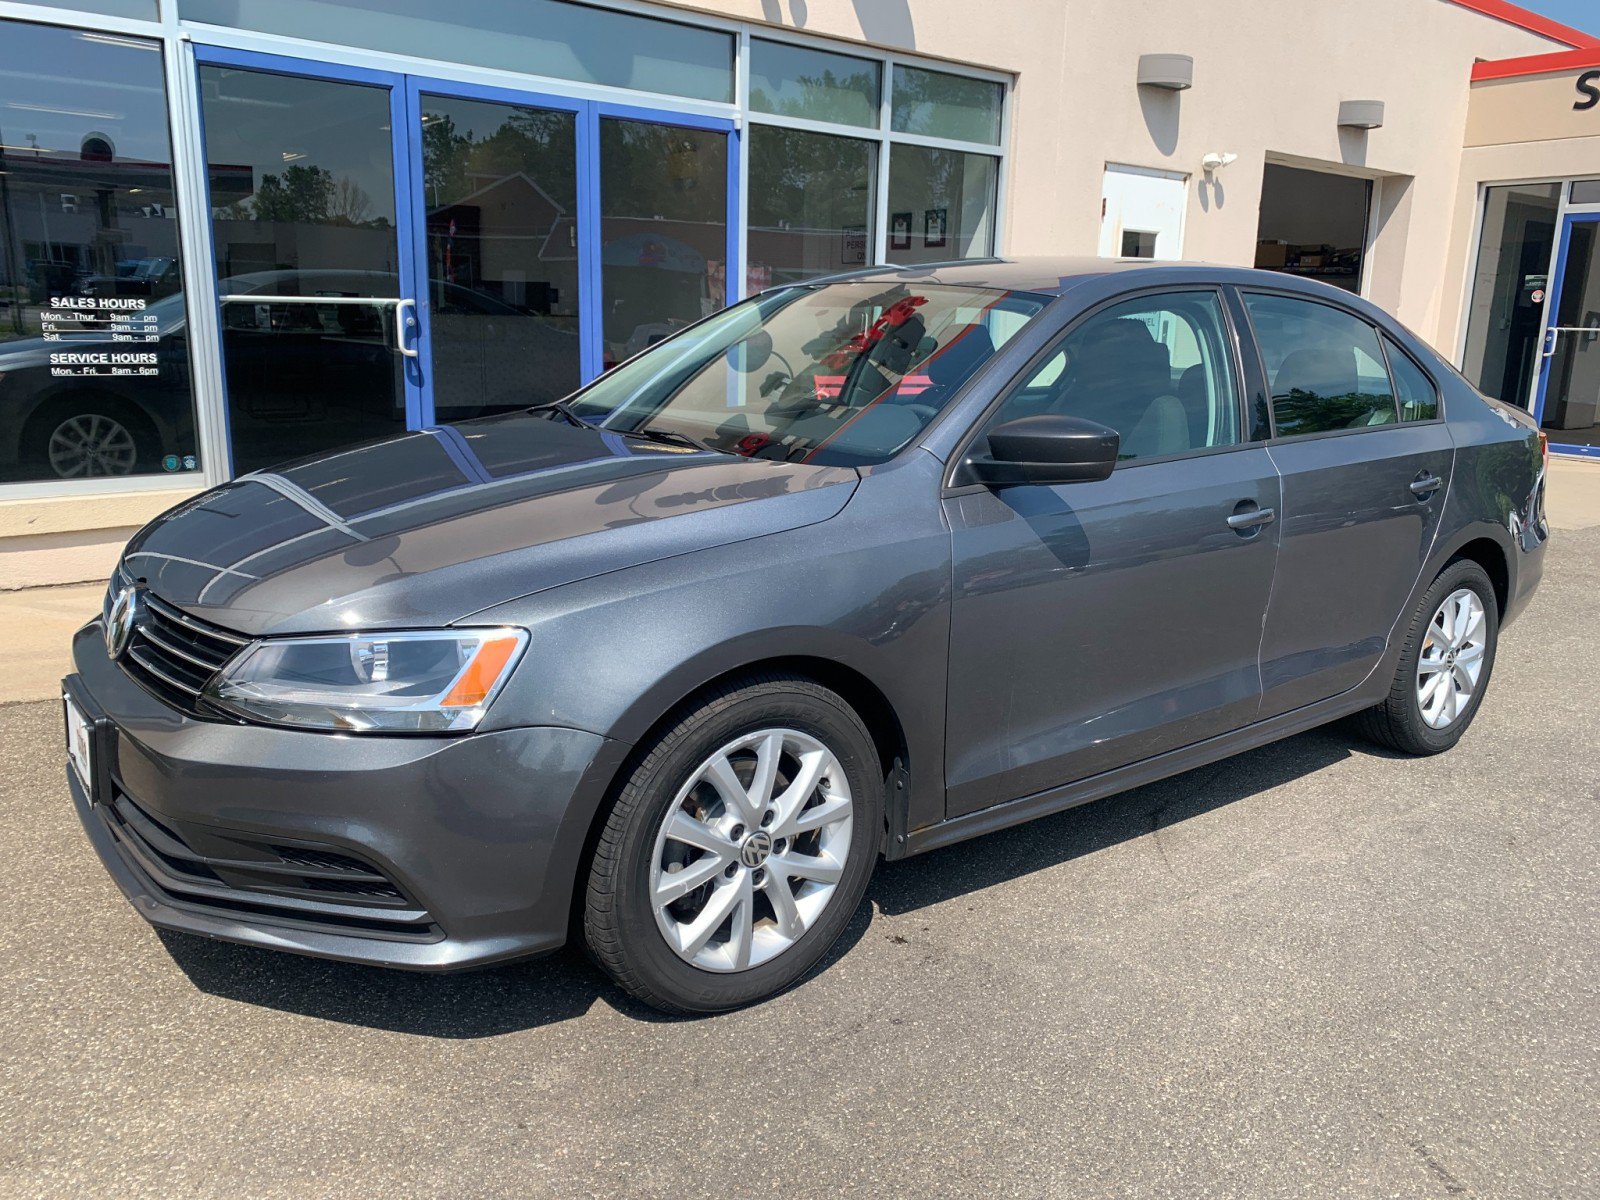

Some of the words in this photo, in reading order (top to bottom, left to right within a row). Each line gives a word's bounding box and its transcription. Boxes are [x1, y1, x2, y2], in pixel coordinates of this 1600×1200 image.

[50, 297, 96, 309] SALES
[98, 298, 146, 310] HOURS
[40, 312, 64, 321] Mon.
[72, 312, 97, 321] Thur.
[109, 313, 130, 322] 9am
[143, 315, 158, 323] pm
[41, 322, 58, 331] Fri.
[110, 323, 131, 332] 9am
[143, 324, 158, 333] pm
[42, 332, 62, 341] Sat.
[112, 333, 132, 342] 9am
[145, 334, 160, 343] pm
[49, 353, 108, 364] SERVICE
[111, 353, 157, 364] HOURS
[50, 367, 75, 375] Mon.
[82, 367, 98, 375] Fri.
[111, 367, 131, 375] 8am
[138, 367, 159, 377] 6pm
